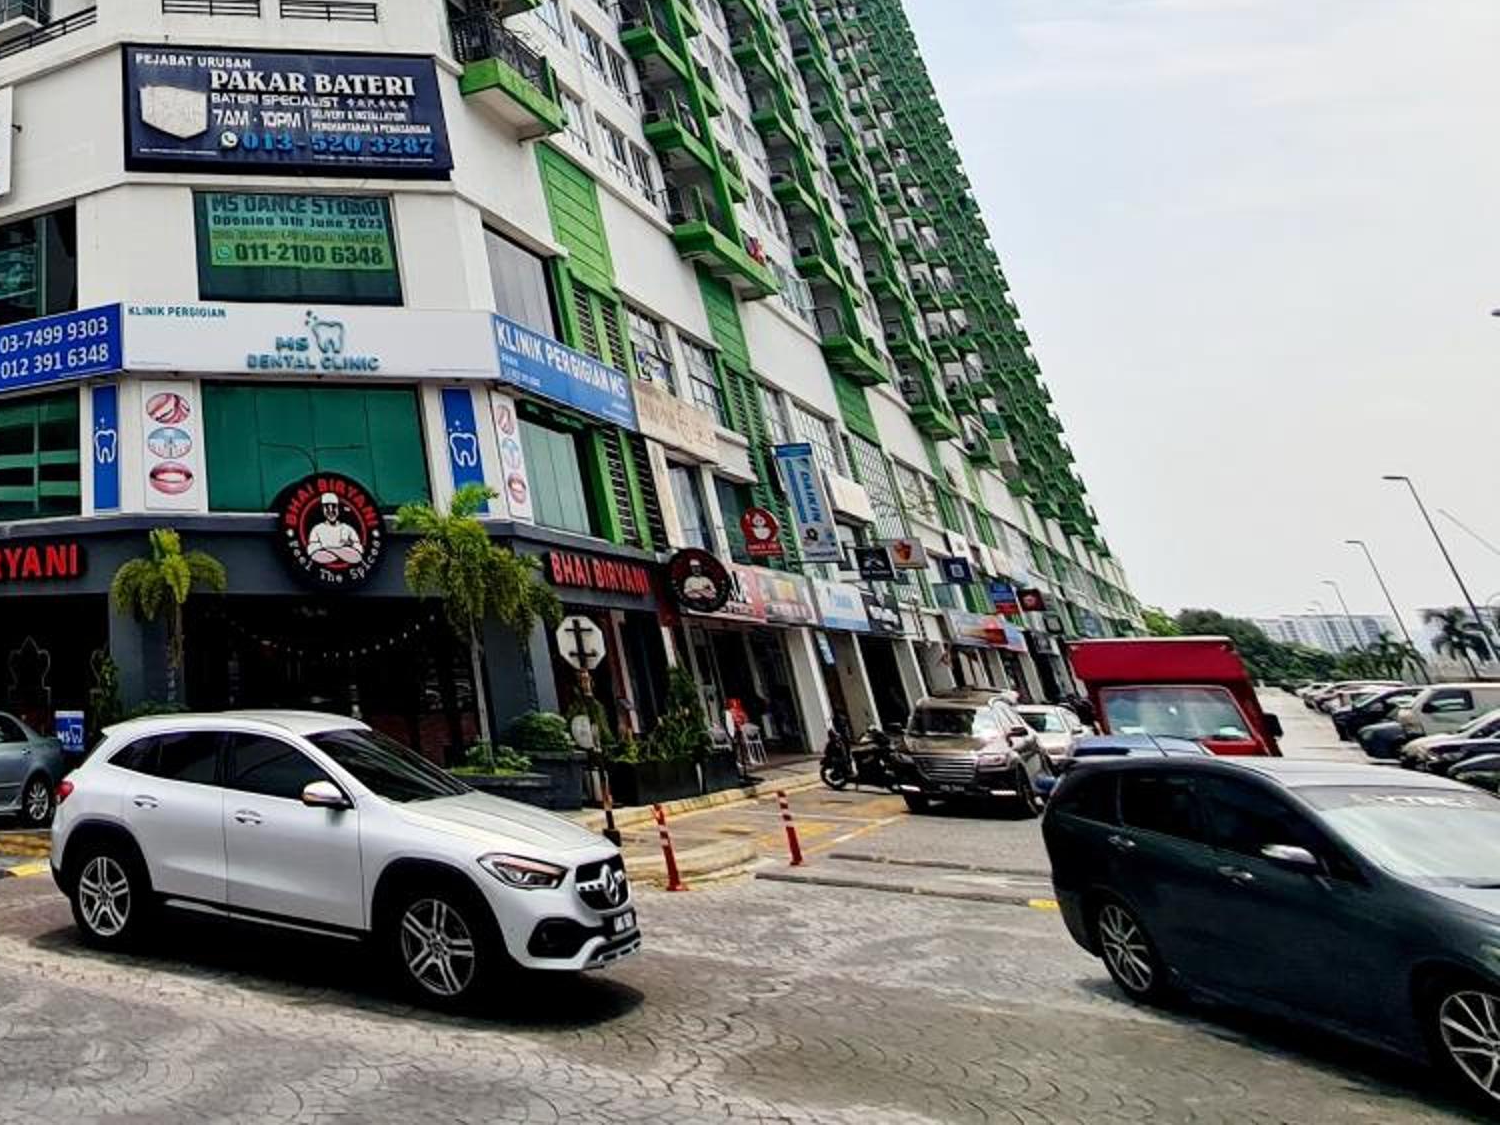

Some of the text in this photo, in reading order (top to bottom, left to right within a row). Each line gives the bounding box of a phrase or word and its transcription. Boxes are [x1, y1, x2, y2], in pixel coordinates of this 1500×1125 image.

[135, 53, 251, 69] PEJABAT URUSAN
[210, 69, 416, 96] PAKAR BATERI
[211, 93, 339, 108] BATERI SPECIALIST
[212, 109, 249, 126] 7AM
[212, 195, 380, 216] MS DANCE STUDIO
[235, 242, 384, 265] 011-2100 6348
[128, 306, 165, 317] KLINIK
[0, 316, 109, 354] 03-7499 9303
[275, 336, 309, 352] MS
[495, 319, 545, 364] KLINIK
[1, 343, 109, 380] 012 391 6348
[247, 354, 380, 371] DENTAL CLINIC
[285, 478, 379, 527] BHAI BIRYANI
[320, 568, 344, 583] The
[550, 550, 651, 595] BHAI BIRYANI
